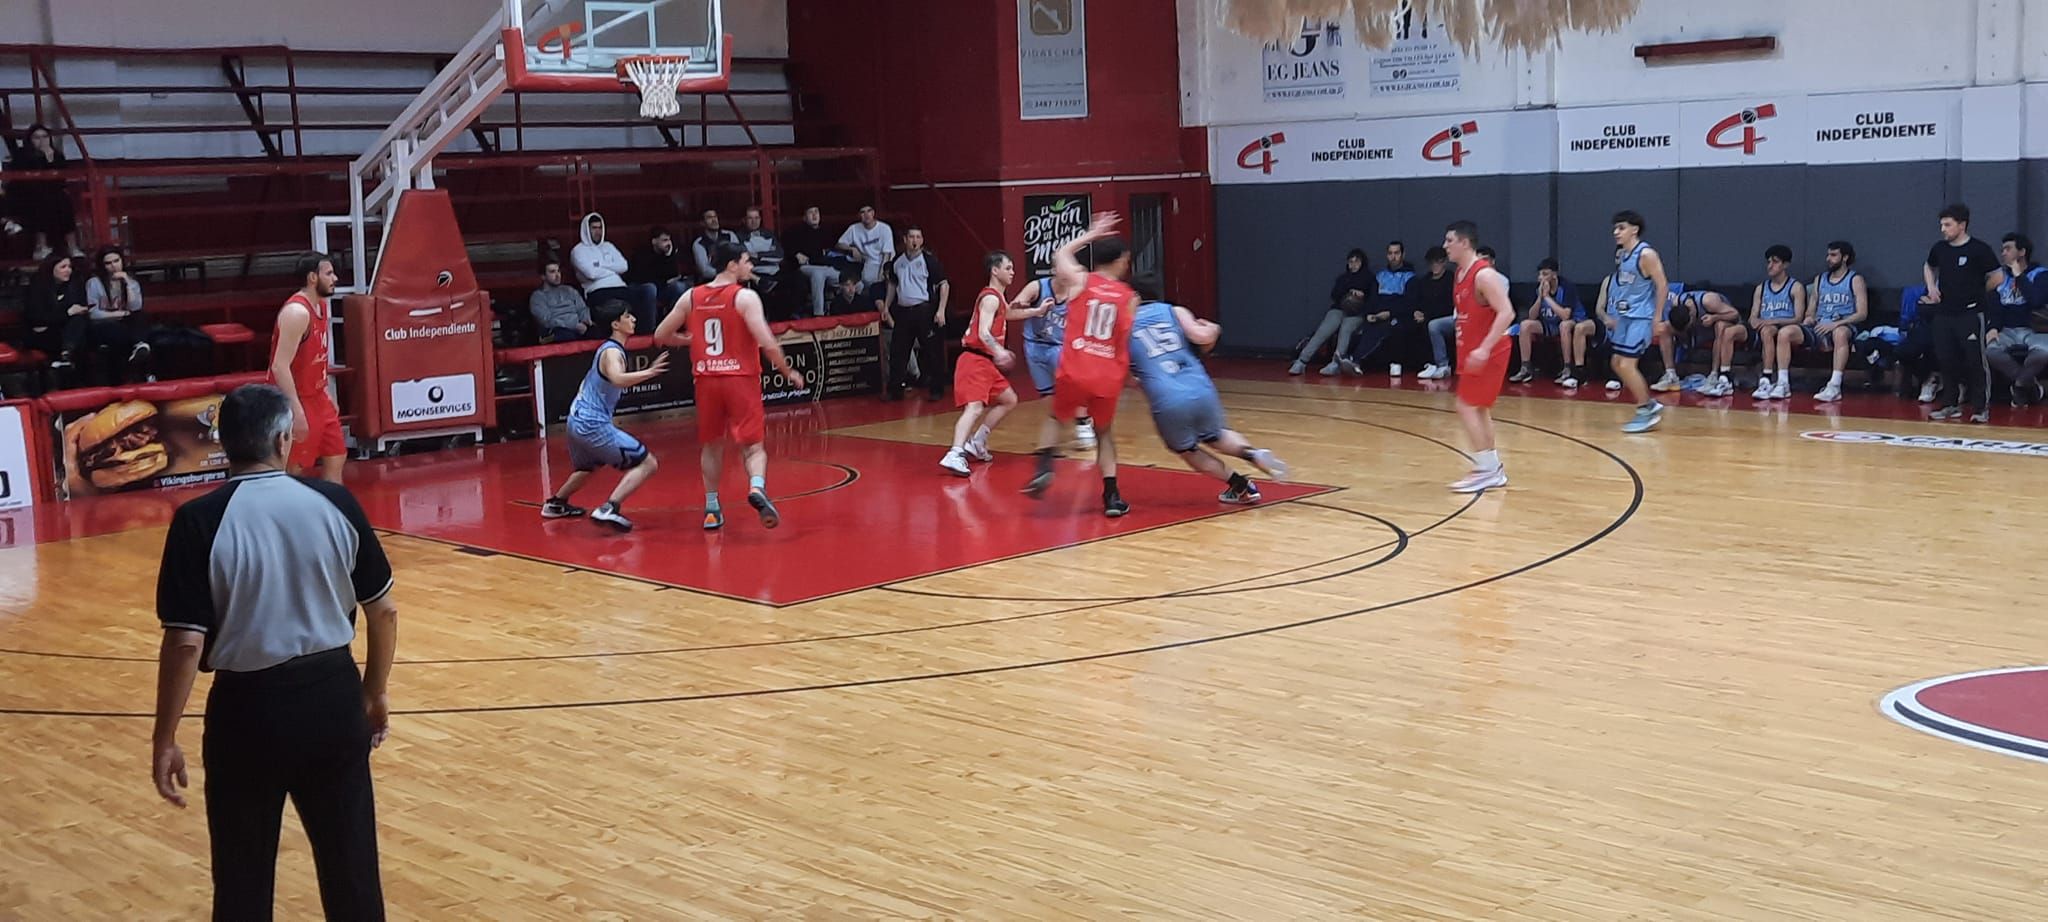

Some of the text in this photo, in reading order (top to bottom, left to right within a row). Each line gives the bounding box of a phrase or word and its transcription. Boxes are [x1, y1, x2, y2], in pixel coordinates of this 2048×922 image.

[1267, 60, 1340, 80] EG JEANS
[1855, 111, 1895, 126] CLUB
[1603, 125, 1636, 137] CLUB
[1816, 123, 1937, 142] INDEPENDIENTE
[1338, 138, 1366, 149] CLUB
[1570, 135, 1671, 152] INDEPENDIENTE
[1311, 149, 1394, 162] INDEPENDIENTE
[385, 322, 476, 341] Club Independiente
[704, 318, 724, 356] 9
[1132, 323, 1183, 358] 15
[763, 370, 816, 389] POLO
[396, 402, 472, 419] MOONSERVICES
